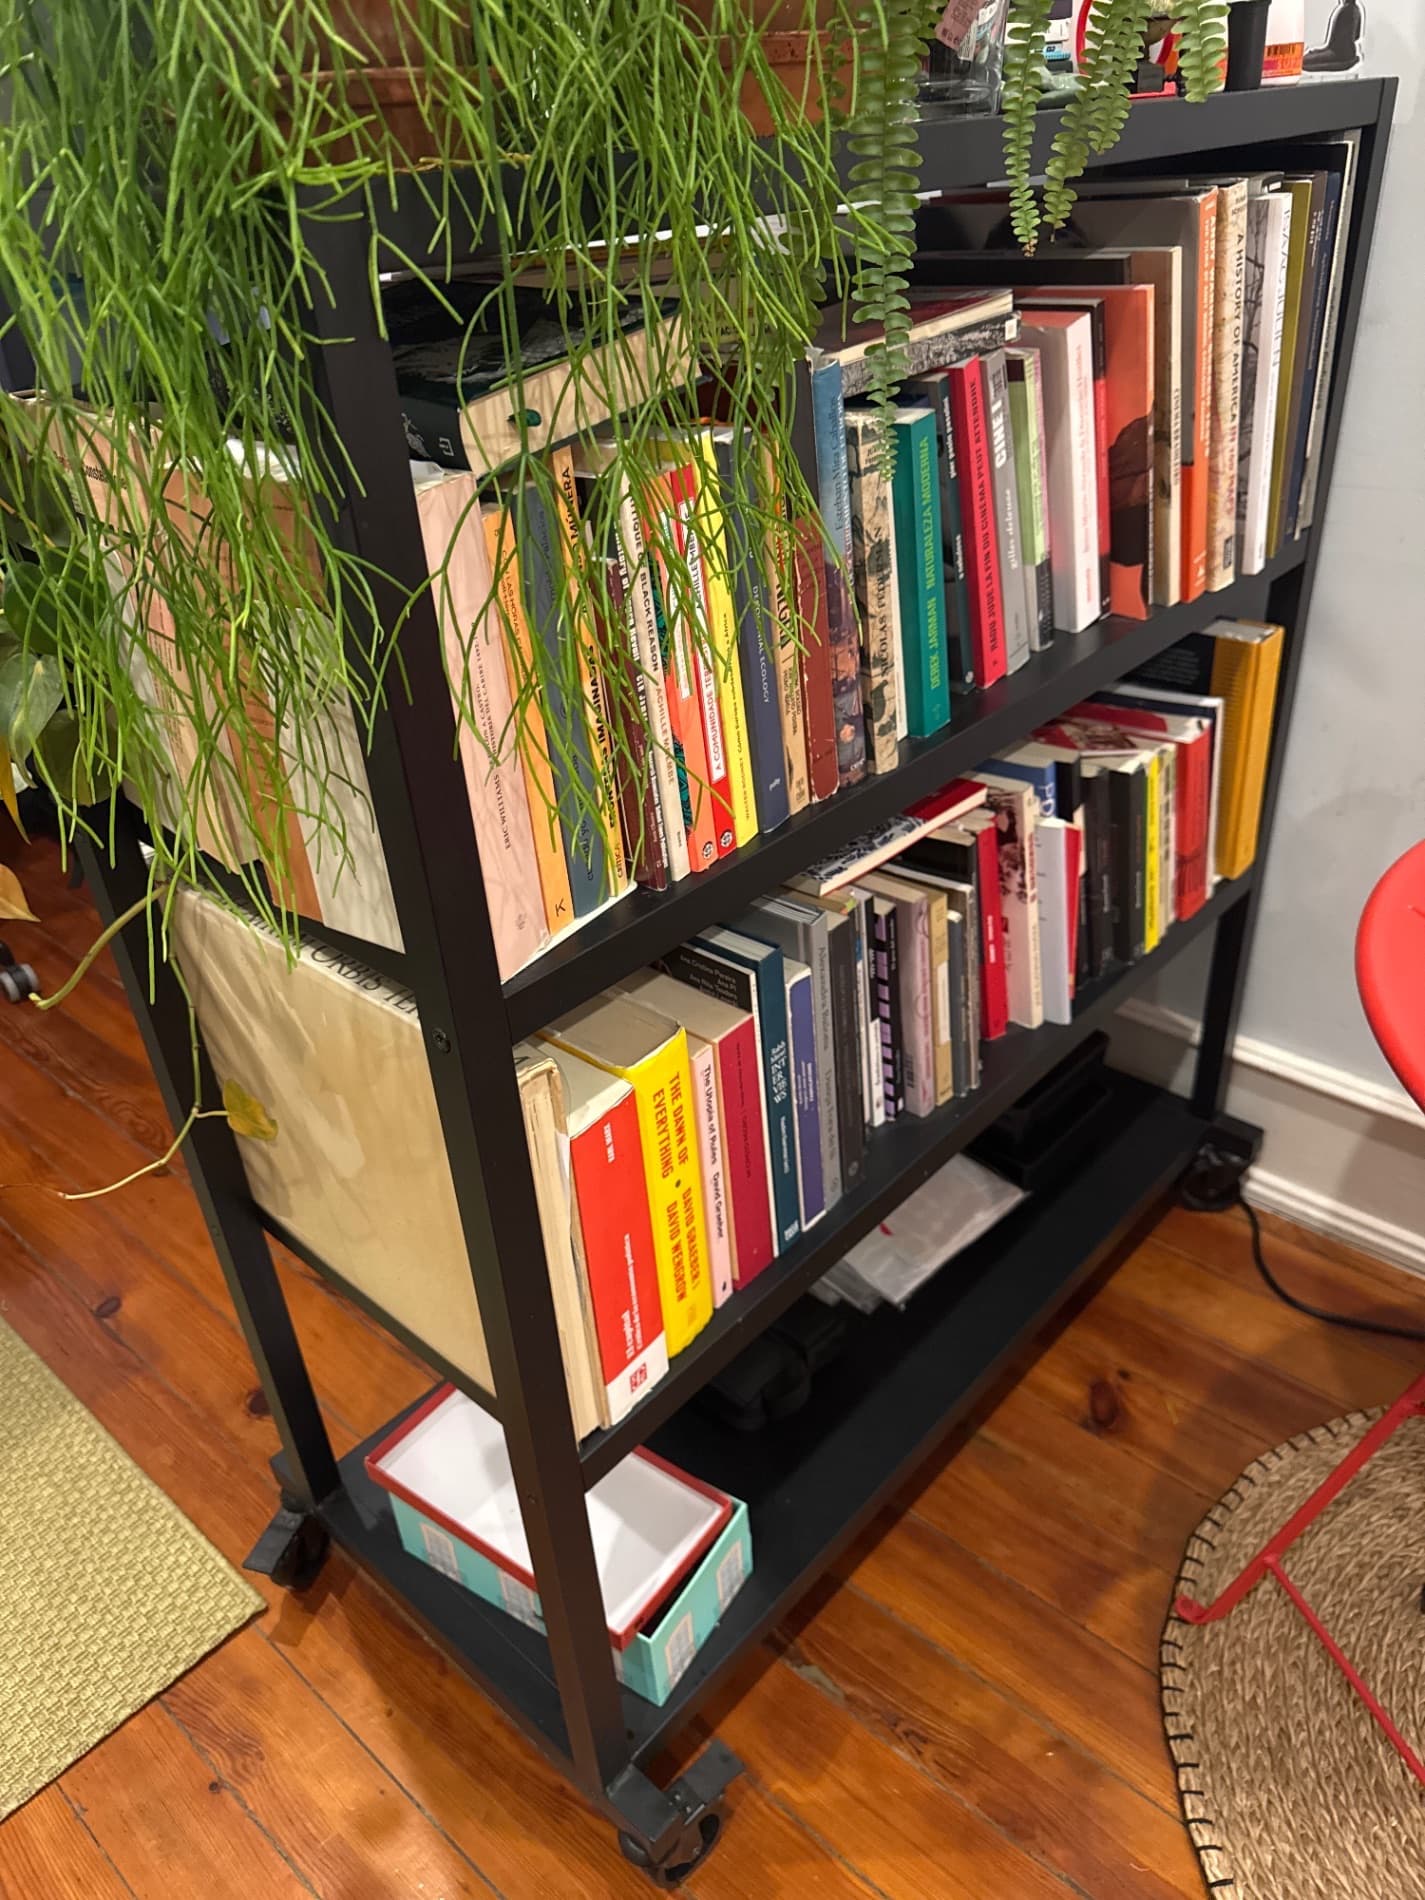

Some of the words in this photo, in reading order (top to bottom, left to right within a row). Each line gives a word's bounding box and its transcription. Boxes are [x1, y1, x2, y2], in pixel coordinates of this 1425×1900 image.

[1208, 215, 1216, 259] ANDY
[1236, 233, 1244, 245] A
[1233, 248, 1244, 320] HISTORY
[1232, 325, 1240, 346] OF
[1229, 352, 1239, 423] AMERICA
[967, 380, 983, 444] ATTENDRE
[989, 411, 1009, 469] CINE
[1228, 425, 1236, 442] IN
[917, 435, 933, 505] MODERNA
[973, 448, 984, 480] PEUT
[974, 482, 989, 530] CINÉMA
[1001, 487, 1015, 535] deleuze
[920, 507, 937, 589] NATURALEZA
[979, 531, 989, 548] DU
[1006, 538, 1018, 570] gilles
[980, 550, 991, 571] FIN
[983, 571, 993, 587] LA
[505, 577, 514, 597] LAS
[639, 572, 652, 618] BLACK
[984, 587, 997, 617] JUDE
[508, 599, 519, 631] HORAS
[925, 596, 940, 648] JARMAN
[645, 620, 659, 671] REASON
[877, 614, 890, 675] NICOLAS
[986, 621, 999, 652] RADU
[758, 656, 770, 703] ECOLOGY
[928, 652, 942, 689] DEREK
[655, 687, 668, 737] ACHILLE
[704, 690, 722, 761] COMUNIDADE
[492, 773, 507, 824] WILLIAMS
[501, 824, 511, 849] ERIC
[555, 899, 568, 918] K
[311, 943, 382, 992] ORBIS
[667, 1071, 683, 1106] THE
[702, 1064, 712, 1087] The
[703, 1087, 715, 1122] Utopia
[649, 1088, 676, 1179] EVERYTHING
[670, 1104, 688, 1147] DAWN
[707, 1122, 716, 1133] of
[676, 1146, 689, 1166] OF
[708, 1133, 719, 1165] Rules
[711, 1171, 721, 1200] David
[665, 1200, 682, 1241] DAVID
[679, 1186, 696, 1227] DAVID
[714, 1201, 725, 1239] Graeber
[668, 1240, 689, 1303] WENGROW
[684, 1226, 702, 1282] GRAEBER
[620, 1308, 636, 1347] capital
[624, 1345, 636, 1359] El
